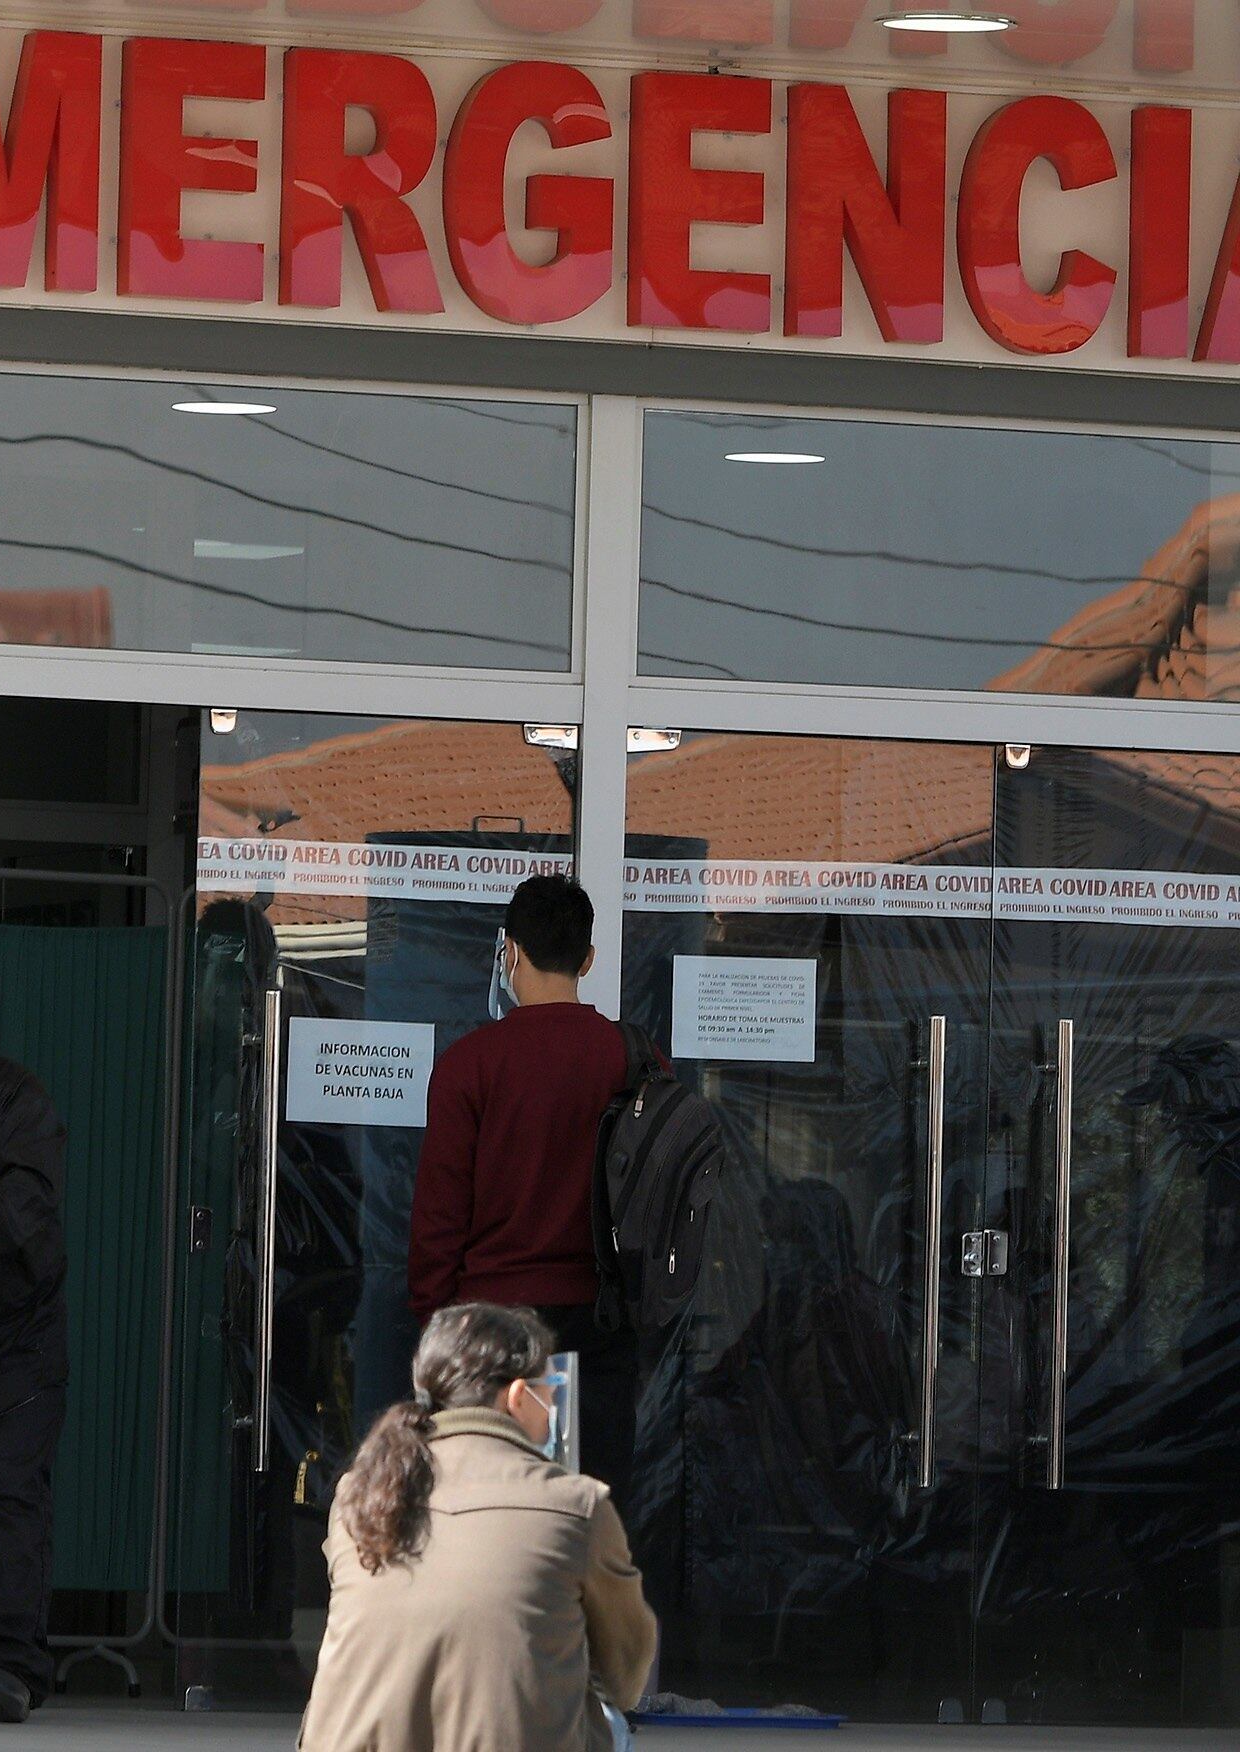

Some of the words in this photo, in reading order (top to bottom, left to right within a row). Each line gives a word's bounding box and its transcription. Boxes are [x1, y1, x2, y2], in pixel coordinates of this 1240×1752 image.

[228, 843, 287, 862] COVID
[292, 846, 340, 865] AREA
[348, 848, 407, 869] COVID
[411, 852, 460, 872] AREA
[467, 855, 526, 875] COVID
[230, 870, 241, 879] EL
[244, 871, 286, 880] INGRESO
[293, 873, 347, 884] PROHIBIDO
[349, 875, 360, 884] EL
[363, 876, 405, 887] INGRESO
[412, 879, 466, 891] PROHIBIDO
[468, 882, 479, 891] EL
[482, 883, 517, 894] INGRES
[642, 867, 692, 885] AREA
[698, 868, 757, 886] COVID
[761, 870, 811, 888] AREA
[817, 871, 877, 889] COVID
[880, 873, 928, 891] AREA
[935, 875, 992, 893] COVID
[997, 877, 1043, 895] AREA
[1049, 878, 1107, 897] COVID
[1109, 880, 1156, 899] AREA
[1162, 882, 1219, 901] COVID
[644, 893, 698, 904] PROHIBIDO
[702, 895, 712, 904] EL
[715, 895, 757, 905] INGRESO
[765, 896, 818, 906] PROHIBIDO
[820, 897, 831, 906] EL
[834, 897, 875, 907] INGRESO
[882, 899, 934, 910] PROHIBIDO
[937, 901, 948, 910] EL
[950, 902, 991, 912] INGRESO
[999, 902, 1050, 913] PROHIBIDO
[1053, 904, 1064, 913] EL
[1066, 905, 1105, 915] INGRESO
[1111, 906, 1162, 917] PROHIBIDO
[1165, 908, 1176, 918] EL
[1179, 909, 1219, 919] INGRESO
[320, 1042, 410, 1058] INFORMACION
[315, 1063, 330, 1075] DE
[334, 1064, 394, 1078] VACUNAS
[397, 1068, 414, 1080] EN
[323, 1084, 371, 1098] PLANTA
[374, 1087, 404, 1100] BAJA
